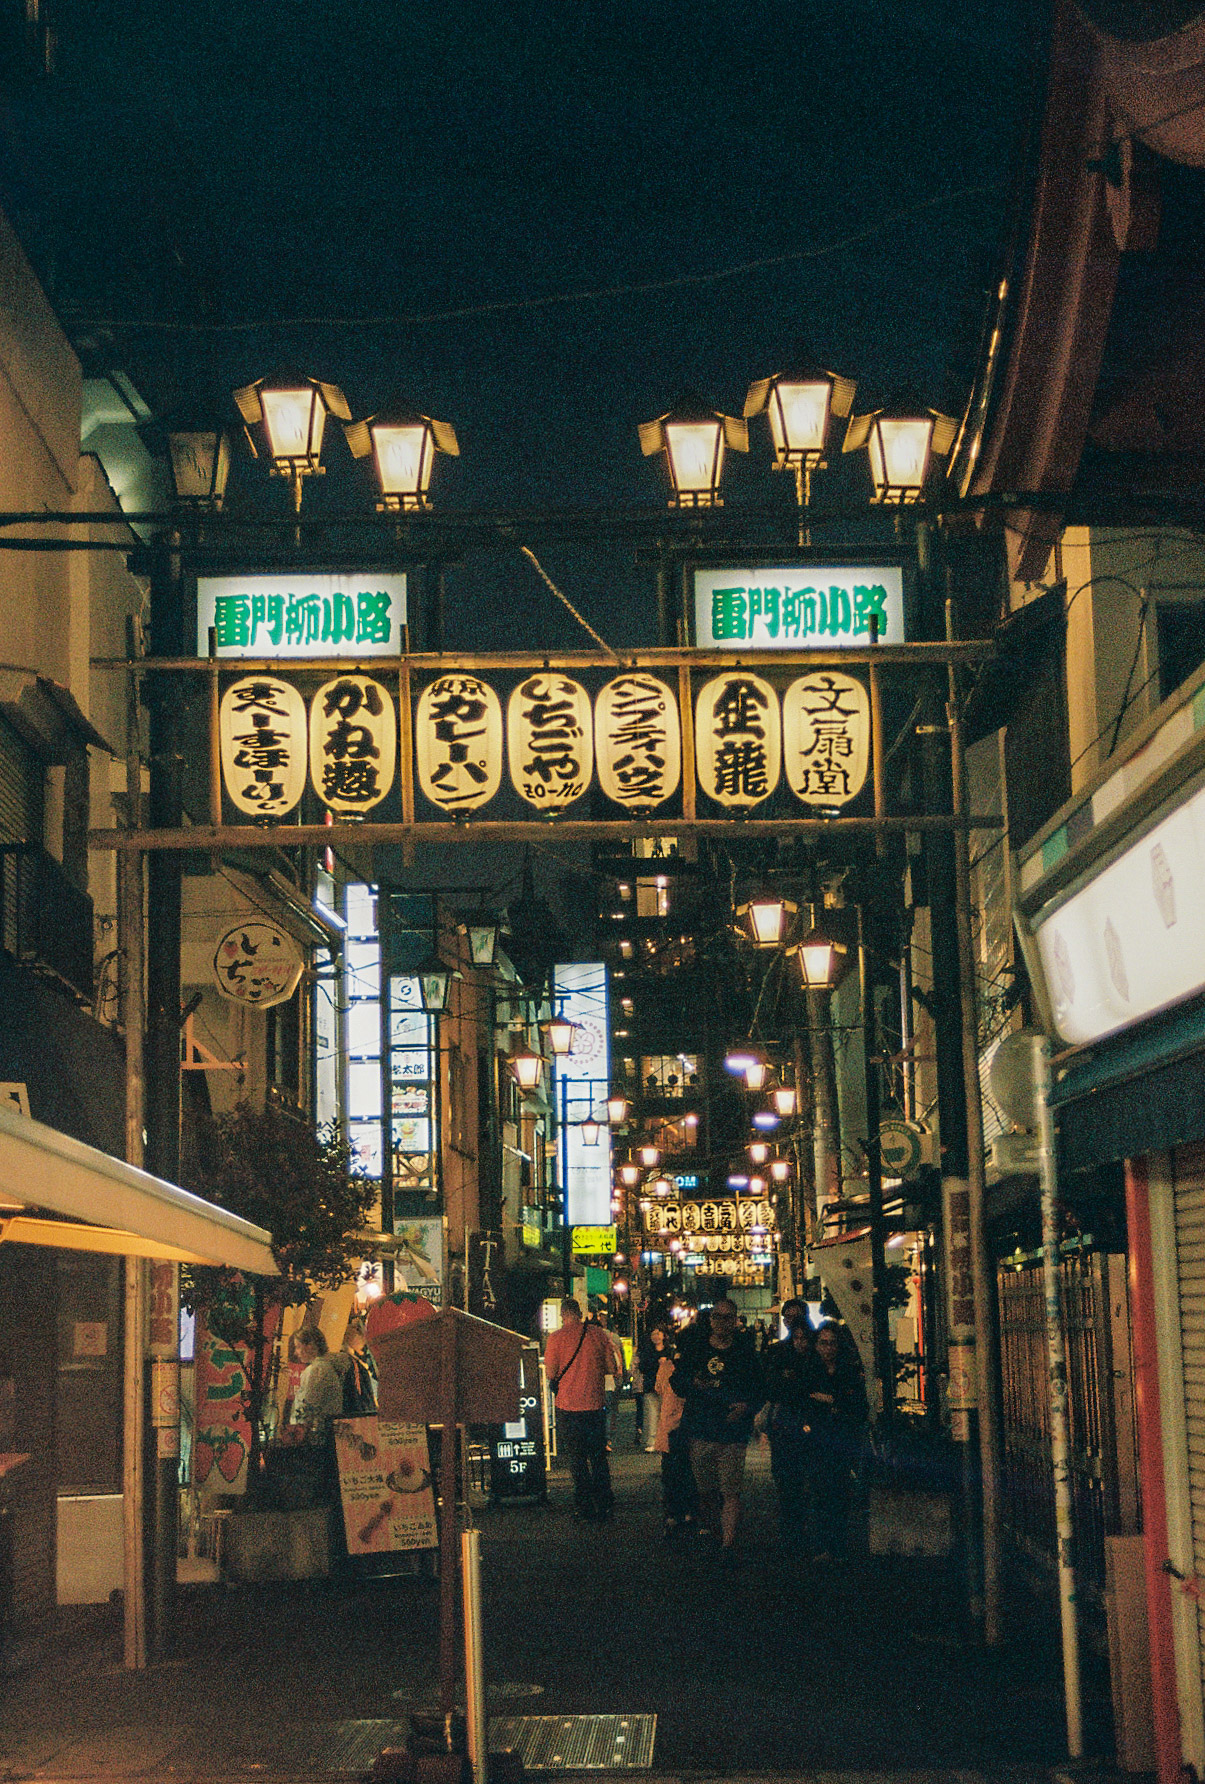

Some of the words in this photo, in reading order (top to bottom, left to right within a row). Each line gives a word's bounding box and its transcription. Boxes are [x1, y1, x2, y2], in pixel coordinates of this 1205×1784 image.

[214, 590, 392, 647] 雷門柳小路
[711, 584, 888, 640] 雷門柳小路
[428, 694, 490, 804] カレーパン
[520, 678, 584, 783] いちごや
[712, 678, 770, 797] 金龍
[796, 676, 861, 796] 文扇堂
[510, 1460, 528, 1474] 5F
